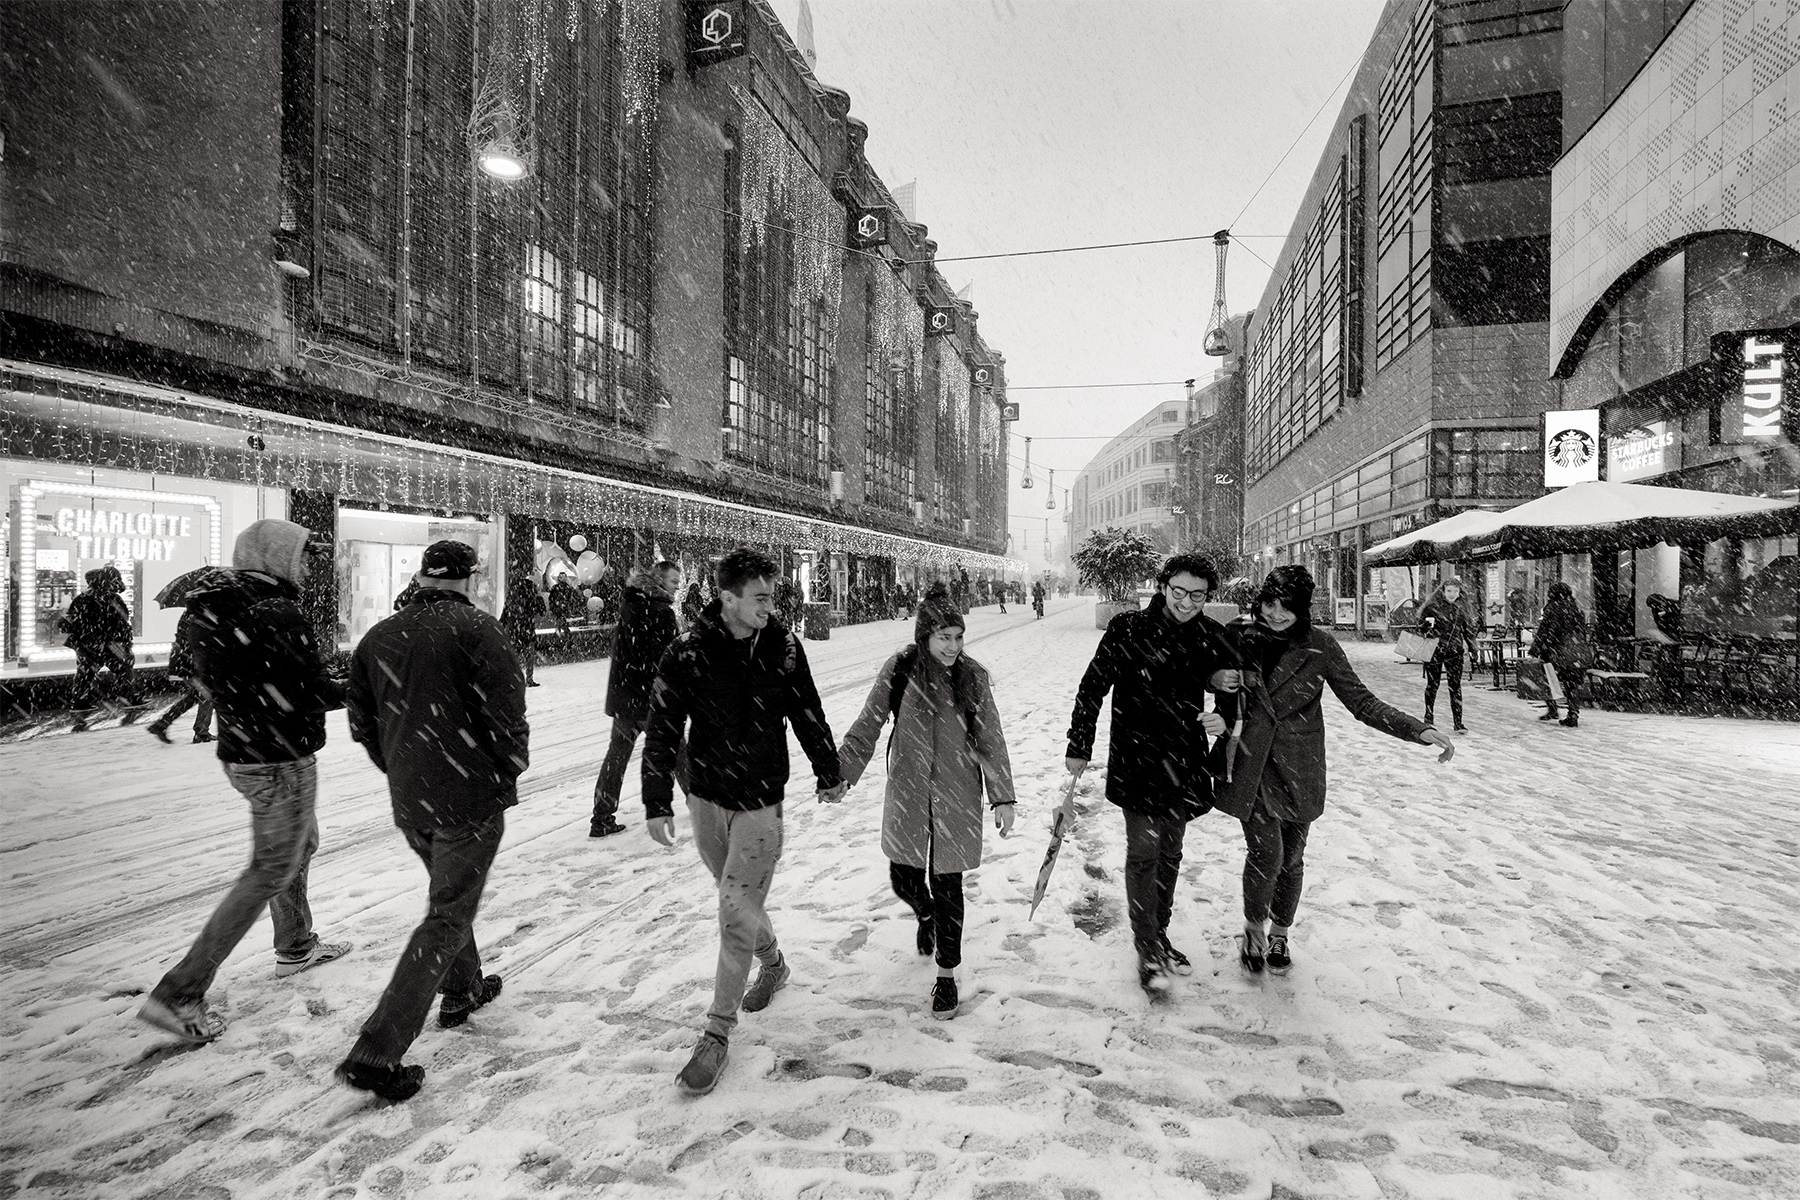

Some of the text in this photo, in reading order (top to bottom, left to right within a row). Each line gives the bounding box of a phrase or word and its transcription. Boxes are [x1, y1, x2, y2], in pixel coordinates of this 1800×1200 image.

[1743, 337, 1782, 436] KULT
[1611, 431, 1674, 460] STARBUCKS
[1622, 451, 1661, 472] COFFEE
[57, 508, 191, 537] CHARLOTTE
[78, 536, 176, 561] TILBURY
